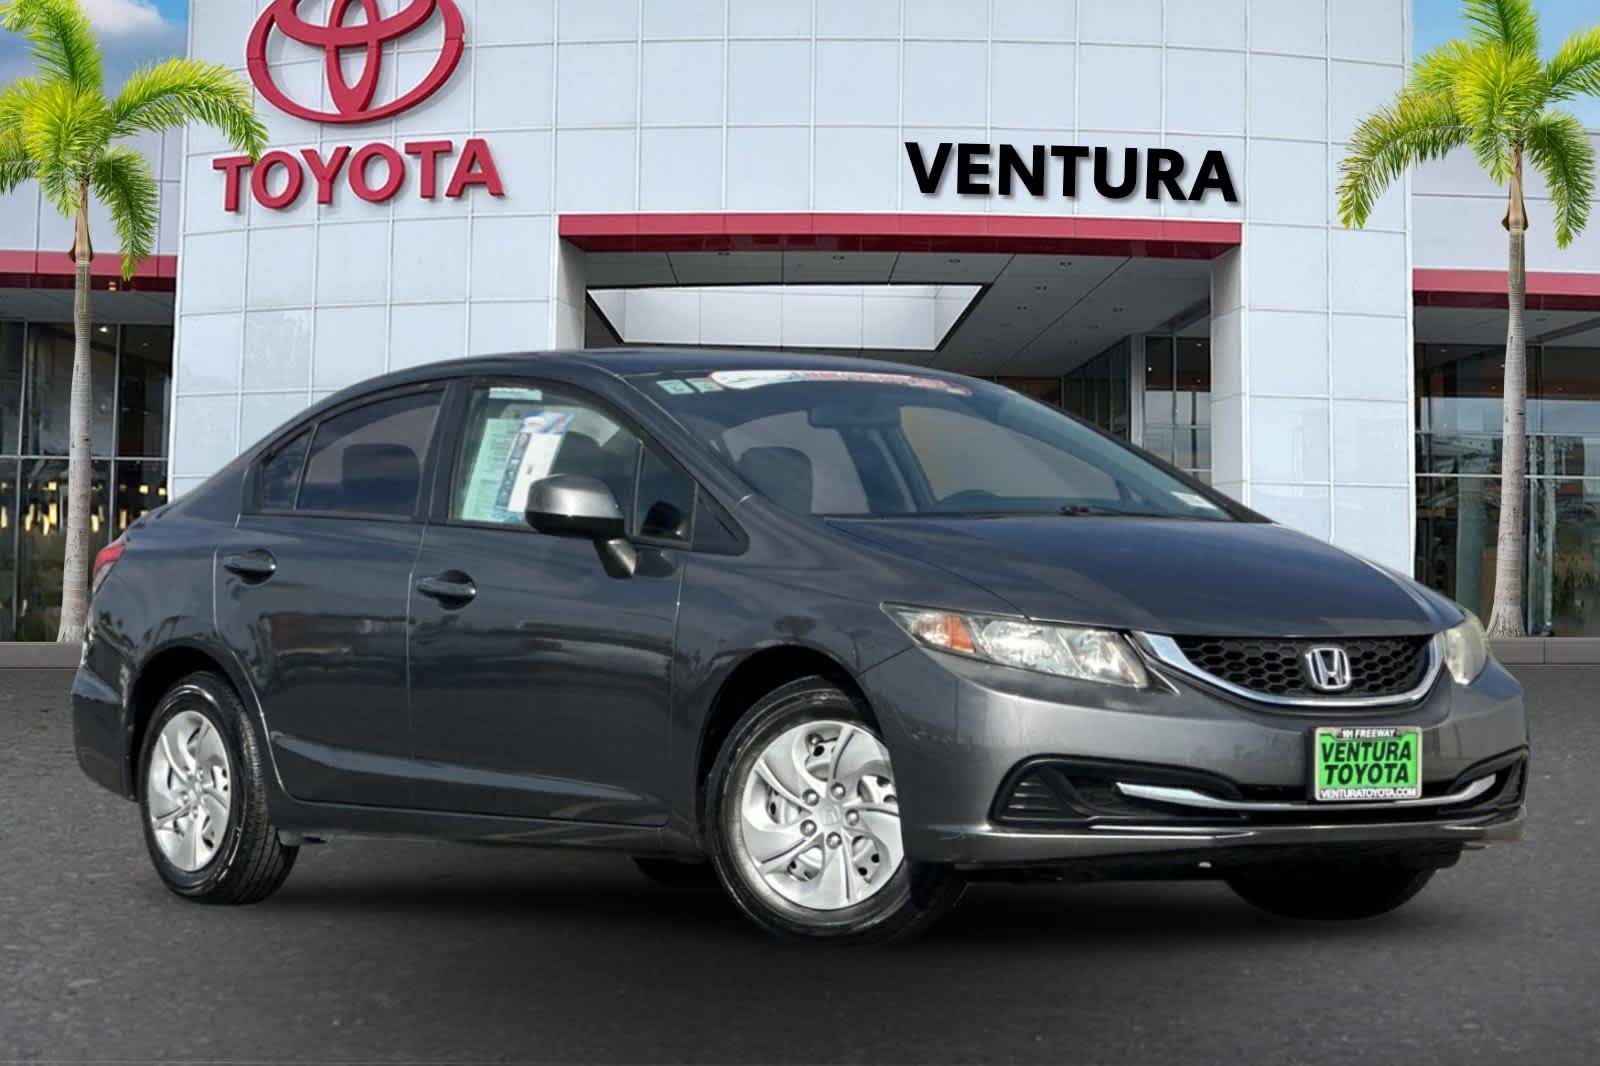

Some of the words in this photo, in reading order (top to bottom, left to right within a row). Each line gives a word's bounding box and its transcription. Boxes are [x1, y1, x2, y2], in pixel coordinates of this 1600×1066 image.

[212, 138, 505, 212] TOYOTA
[904, 141, 1238, 203] VENTURA
[1355, 728, 1396, 738] FREEWAY
[1320, 741, 1412, 762] VENTURA
[1325, 763, 1409, 785] TOYOTA
[1320, 787, 1417, 799] VENTURATOYOTA.COM
